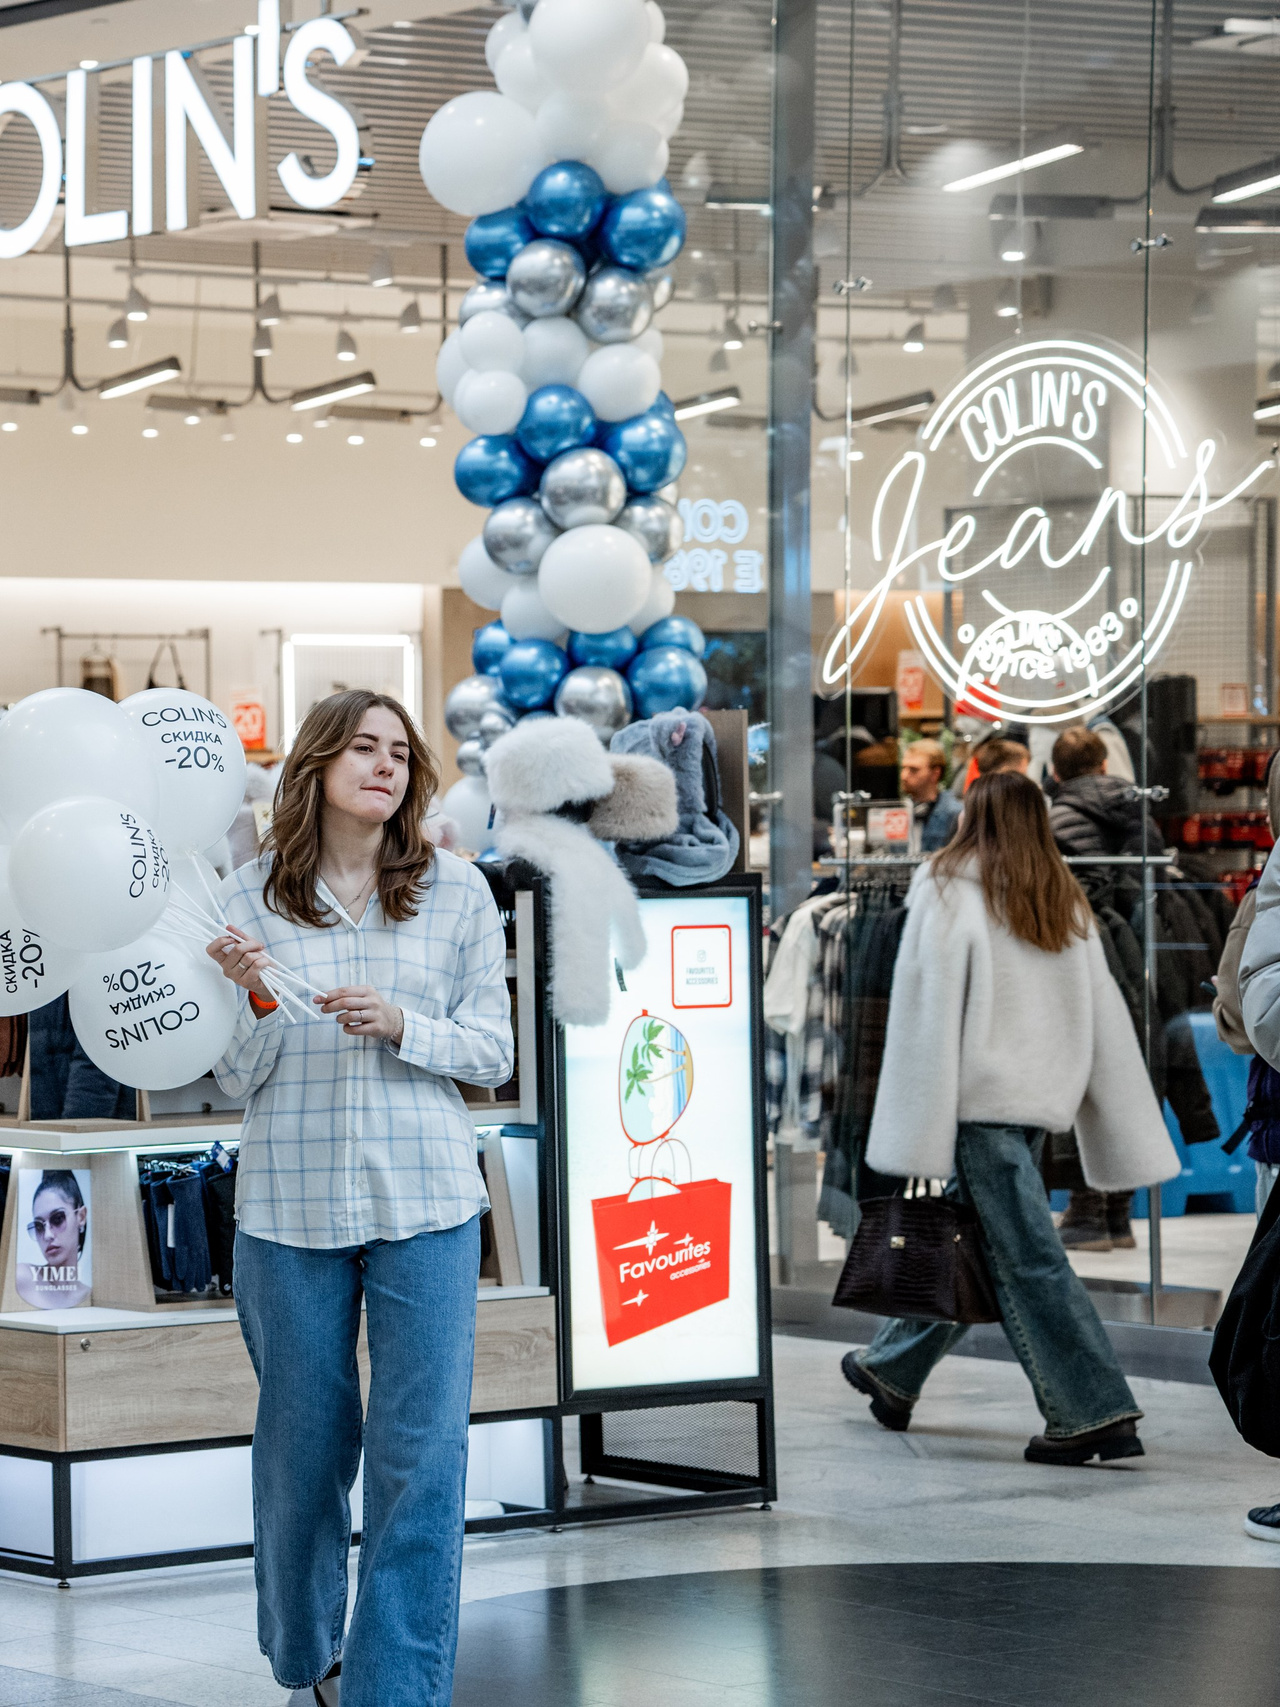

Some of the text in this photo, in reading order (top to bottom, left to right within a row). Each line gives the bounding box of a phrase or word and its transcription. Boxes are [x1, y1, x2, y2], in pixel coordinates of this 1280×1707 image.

[959, 370, 1107, 463] COLIN'S
[822, 439, 1276, 685] Jeans
[1058, 611, 1125, 674] 1983
[141, 707, 227, 729] COLIN'S
[160, 730, 223, 746] СКИДКА
[164, 745, 225, 773] -20%
[119, 812, 148, 899] COLIN'S
[159, 840, 170, 893] -20
[0, 929, 18, 994] СКИДКА
[102, 960, 166, 994] -20%
[109, 983, 176, 1016] СКИДКА
[104, 1001, 200, 1051] COLIN'S
[619, 1240, 711, 1283] Favourites
